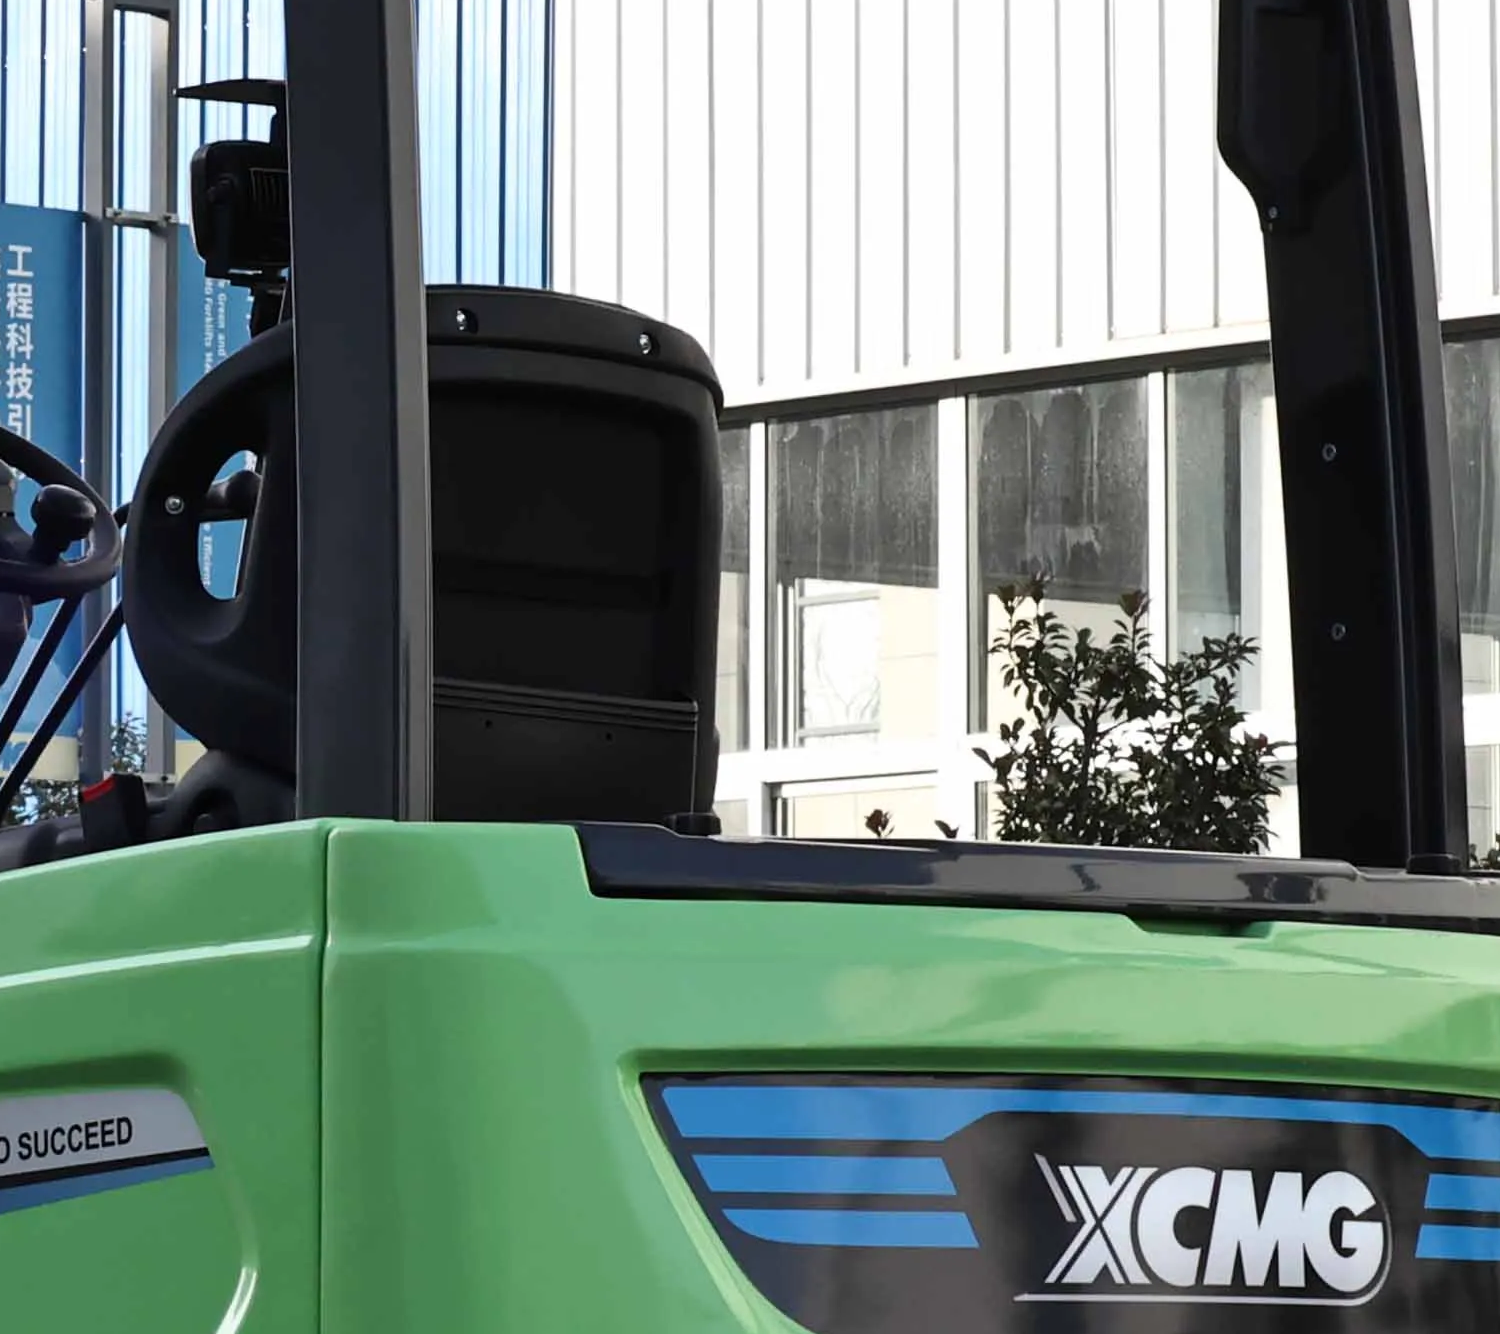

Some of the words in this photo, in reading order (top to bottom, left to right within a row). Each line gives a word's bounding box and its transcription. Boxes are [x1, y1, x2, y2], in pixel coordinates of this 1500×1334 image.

[5, 243, 35, 443] 工程科技引
[17, 1115, 133, 1162] SUCCEED
[1035, 1154, 1386, 1296] XCMG
